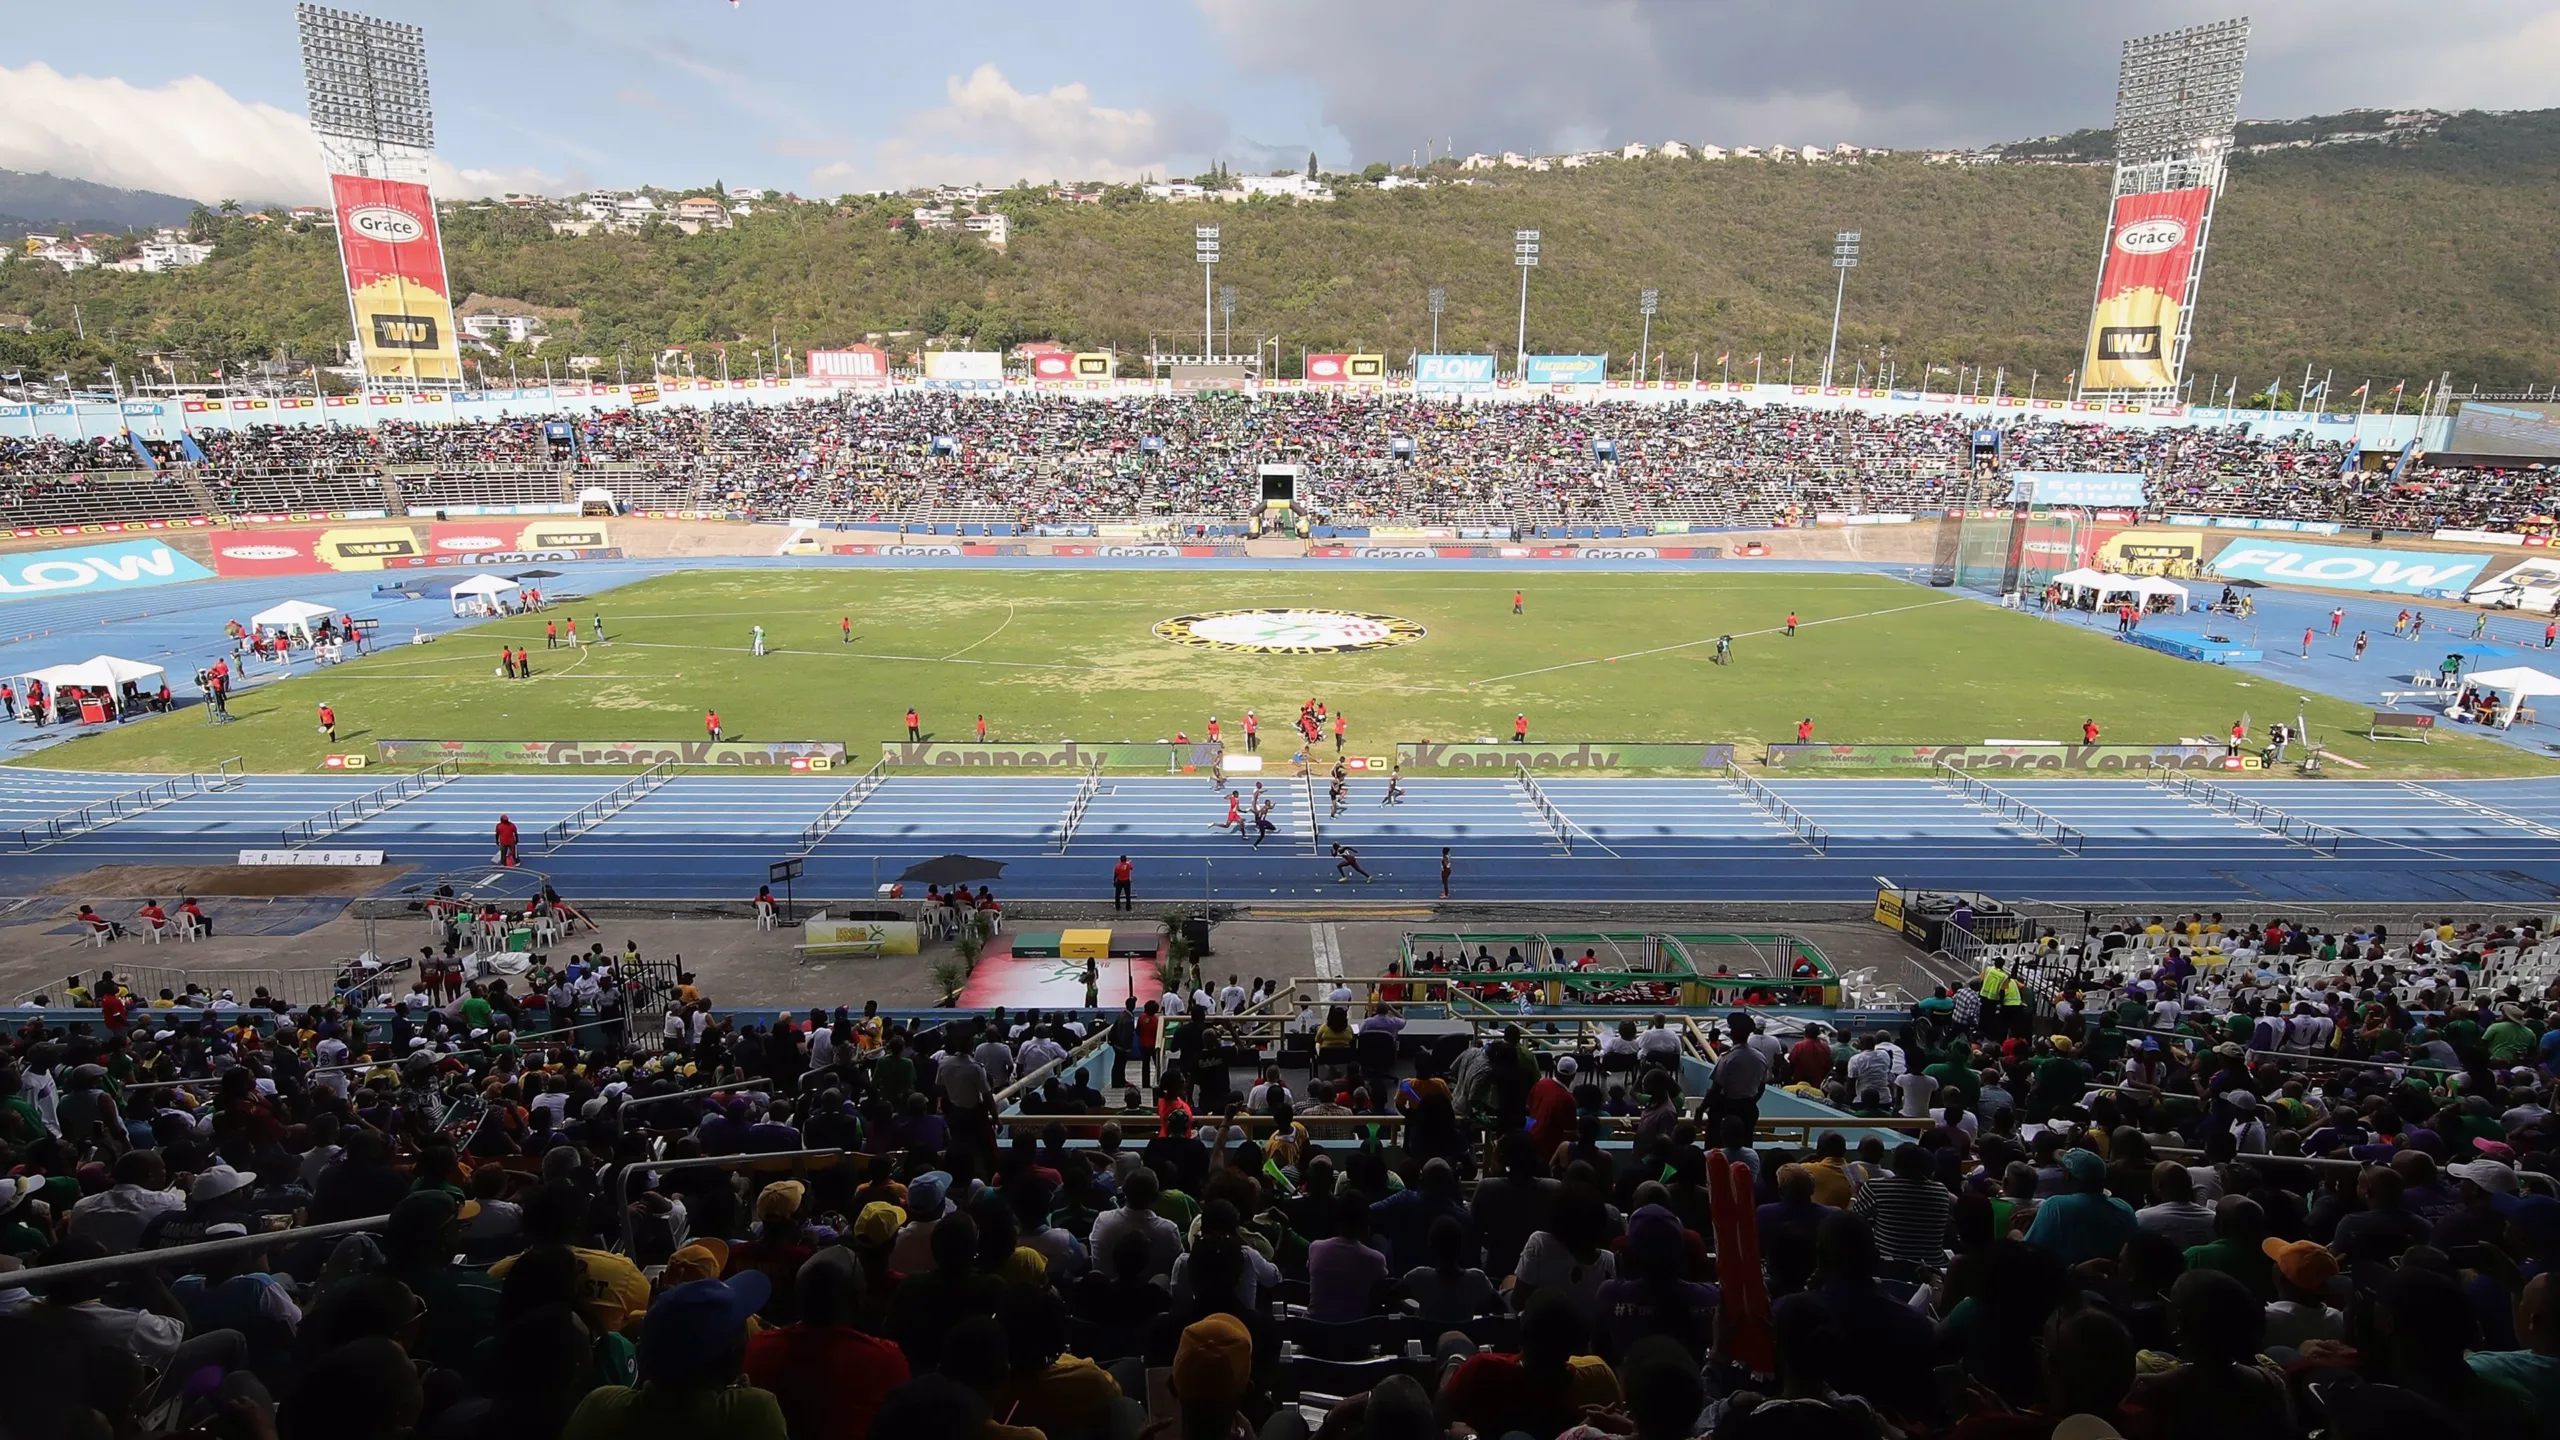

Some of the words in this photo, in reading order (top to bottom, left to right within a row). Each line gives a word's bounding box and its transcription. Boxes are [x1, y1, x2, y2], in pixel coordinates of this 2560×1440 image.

[360, 217, 413, 234] Grace
[2126, 232, 2177, 245] Grace
[382, 321, 427, 342] WU
[2108, 333, 2157, 353] WU
[812, 353, 876, 375] PUMA
[1421, 358, 1488, 380] FLOW
[36, 405, 68, 415] FLOW
[124, 404, 155, 414] FLOW
[2193, 409, 2220, 418] FLOW
[2234, 410, 2263, 420] FLOW
[2277, 412, 2307, 422] FLOW
[2048, 480, 2137, 491] Edwin
[544, 535, 591, 545] WU
[233, 548, 289, 556] Grace
[345, 543, 401, 554] WU
[889, 546, 950, 556] Grace
[1107, 547, 1170, 557] Grace
[1364, 548, 1426, 558] Grace
[1585, 549, 1647, 558] Grace
[2128, 547, 2183, 558] WU
[475, 552, 563, 565] Grace
[2216, 549, 2477, 587] FLOW
[421, 750, 489, 760] GraceKennedy
[1415, 743, 1620, 767] Kennedy
[1810, 754, 1876, 764] GraceKennedy
[261, 853, 268, 862] 8
[293, 853, 299, 862] 7
[324, 853, 330, 862] 6
[355, 853, 361, 862] 5
